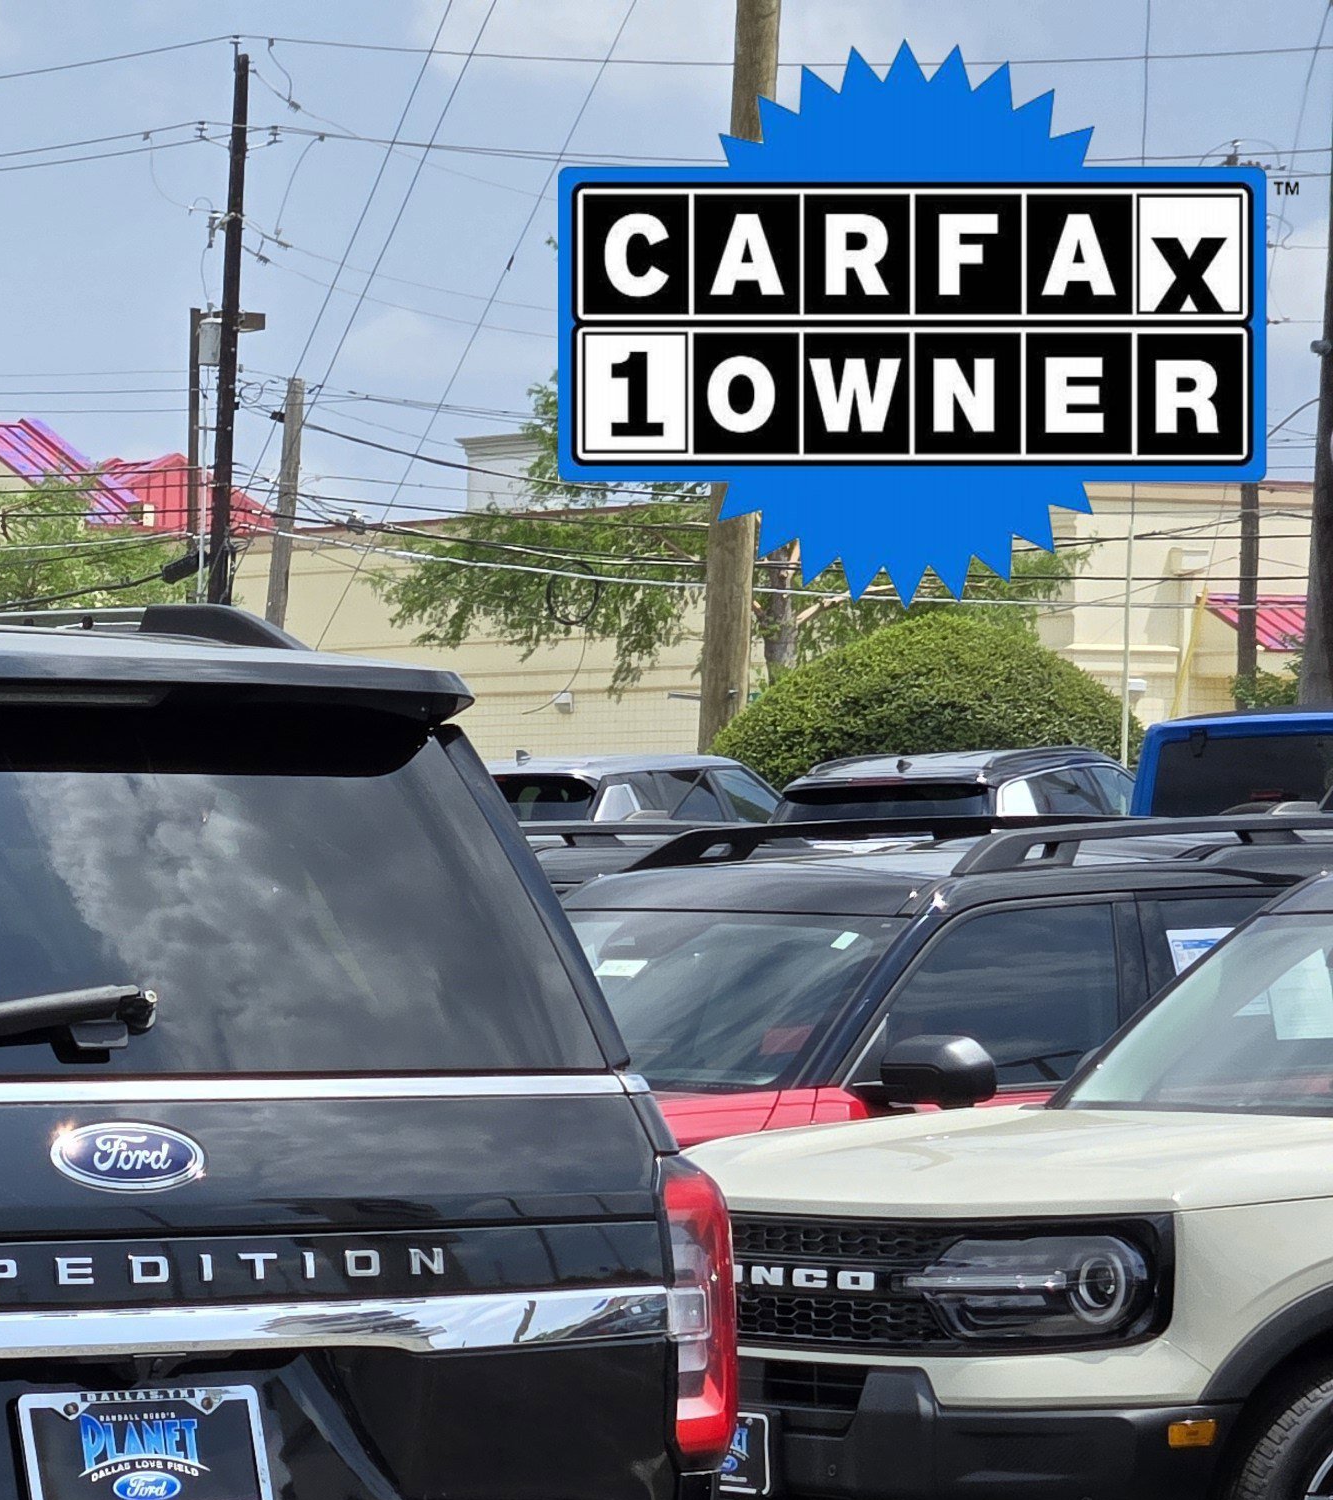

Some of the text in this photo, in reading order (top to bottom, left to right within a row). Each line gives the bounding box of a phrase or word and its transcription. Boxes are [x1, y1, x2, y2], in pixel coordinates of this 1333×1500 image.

[93, 1134, 173, 1172] Ford
[734, 1264, 875, 1291] NCO
[79, 1412, 199, 1471] PLANET
[91, 1460, 199, 1482] DALLAS LOVE FIELD
[126, 1476, 168, 1497] Ford
